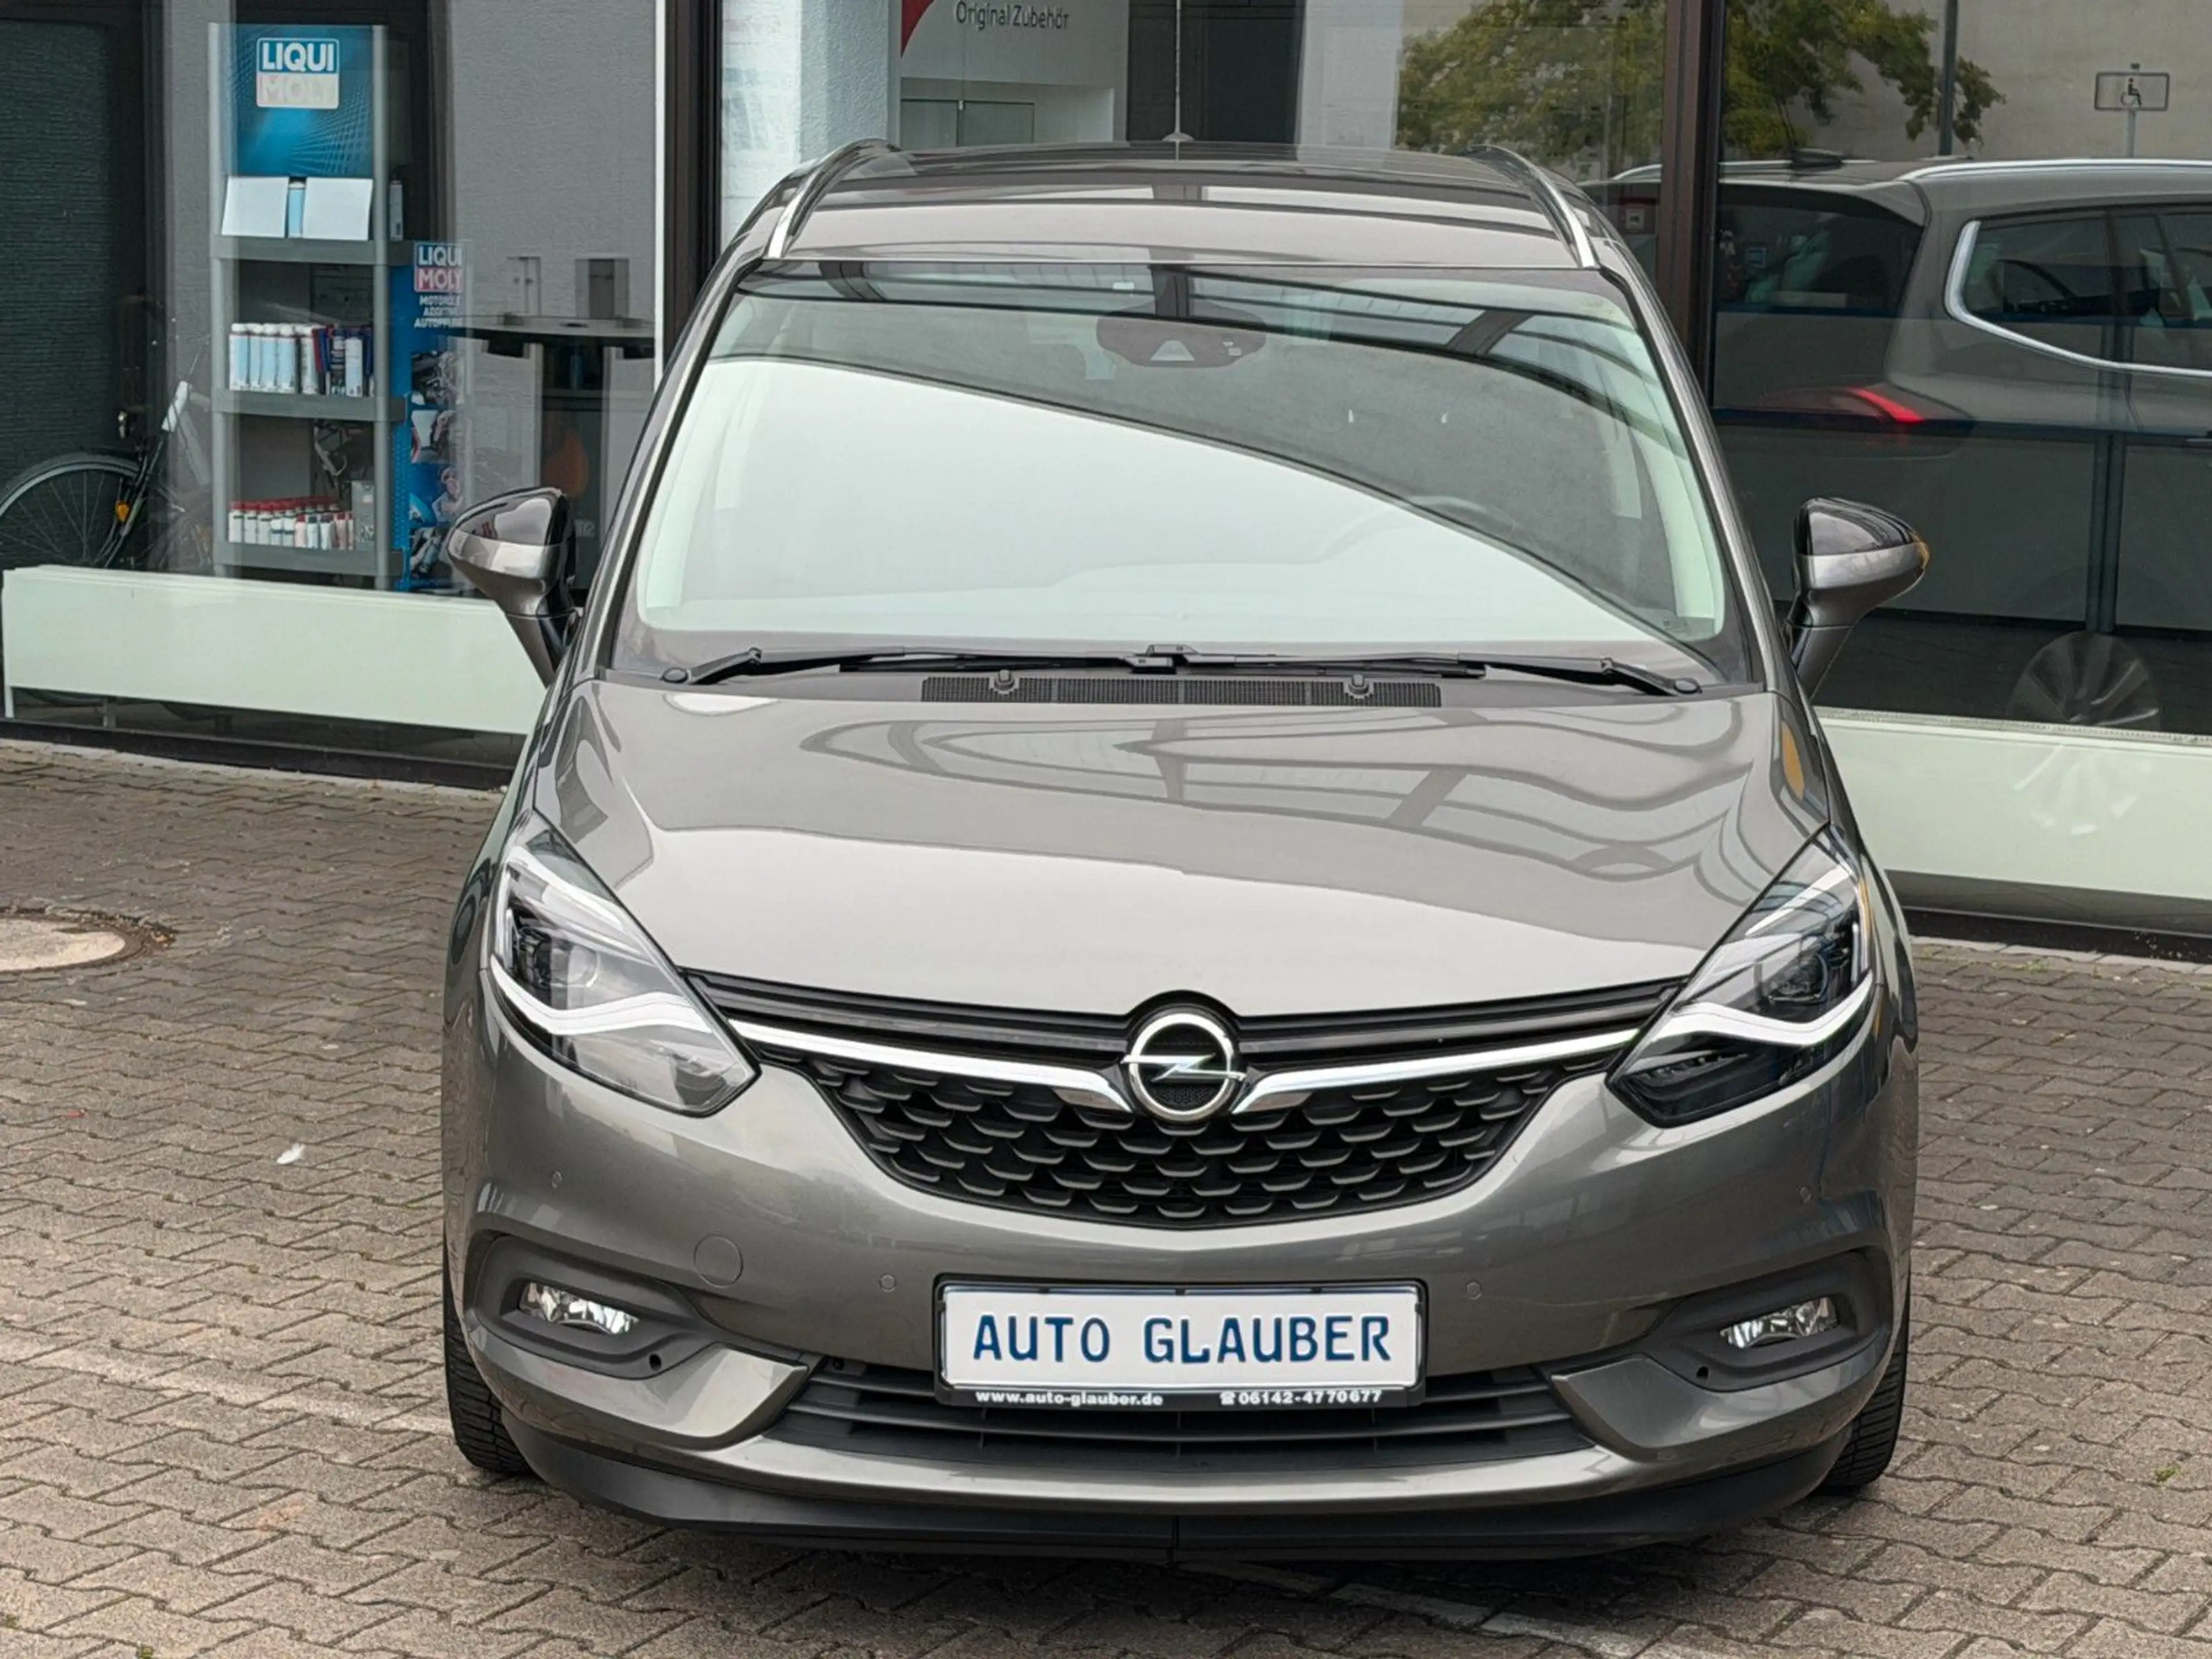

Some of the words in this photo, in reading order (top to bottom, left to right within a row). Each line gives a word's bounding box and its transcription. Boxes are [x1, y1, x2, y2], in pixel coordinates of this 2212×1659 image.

[956, 1, 1010, 30] Original
[1012, 5, 1070, 29] Zubehör
[262, 42, 334, 73] LIQUI
[418, 245, 462, 267] LIQUI
[418, 268, 463, 289] MOLY
[973, 1314, 1110, 1363] AUTO
[1143, 1316, 1392, 1364] GLAUBER
[975, 1391, 1164, 1407] www.auto-glauber.de
[1238, 1389, 1382, 1404] 06142-4770677
